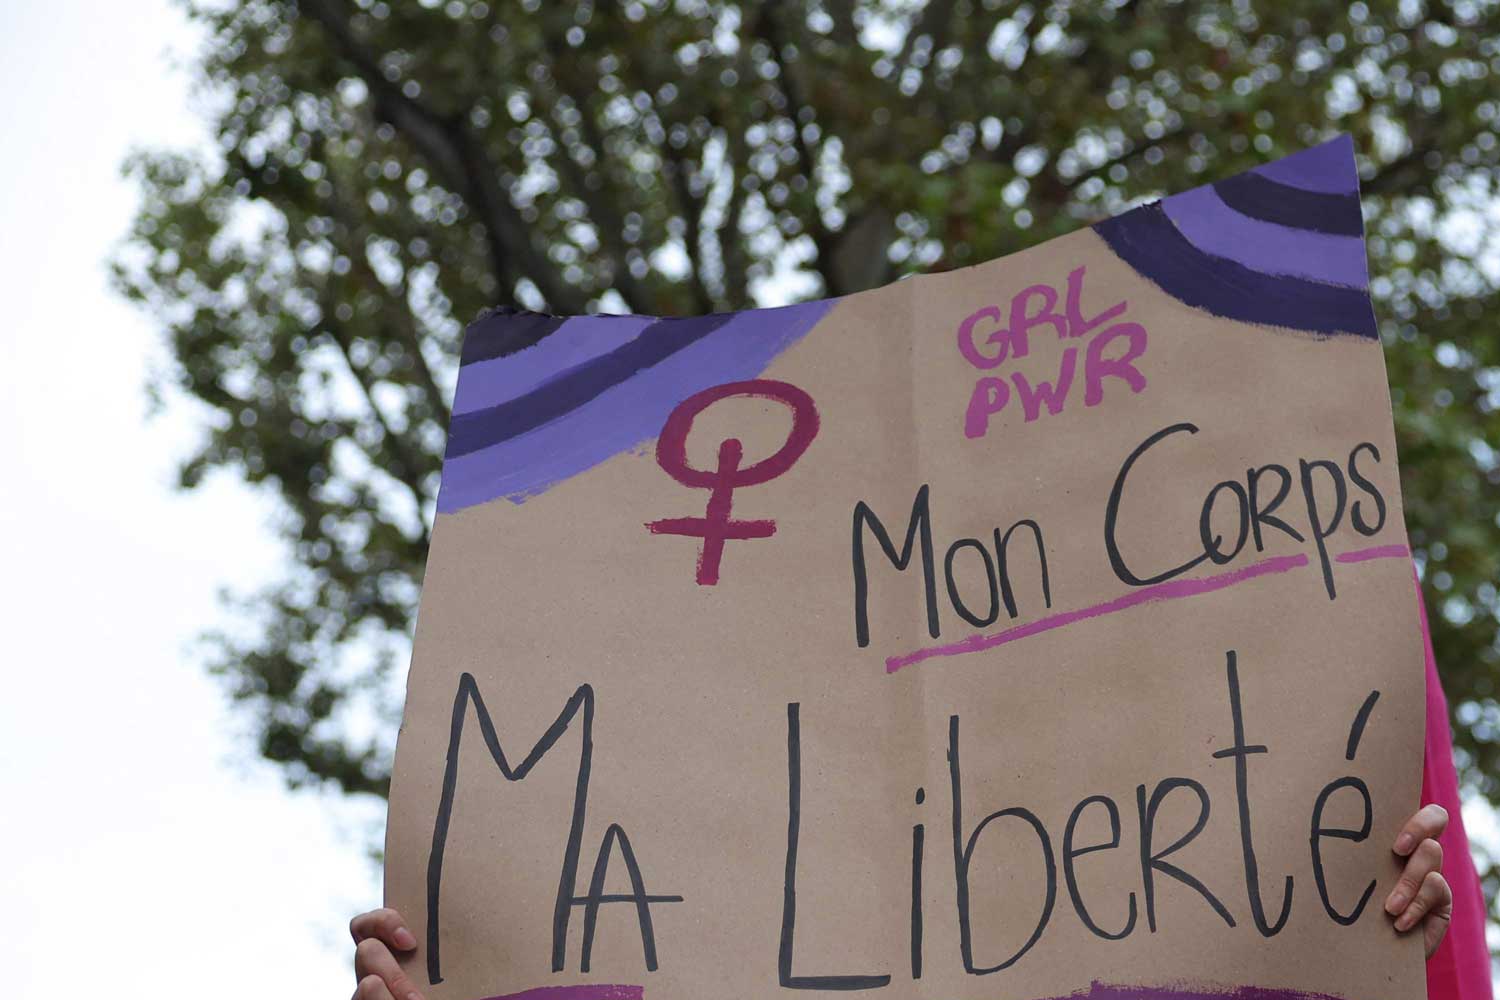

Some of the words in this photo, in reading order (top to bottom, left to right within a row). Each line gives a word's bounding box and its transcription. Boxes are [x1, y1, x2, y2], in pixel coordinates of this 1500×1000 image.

[957, 265, 1128, 370] GRL
[964, 322, 1148, 440] PWR
[853, 484, 1050, 647] Mon
[427, 671, 684, 985] MA
